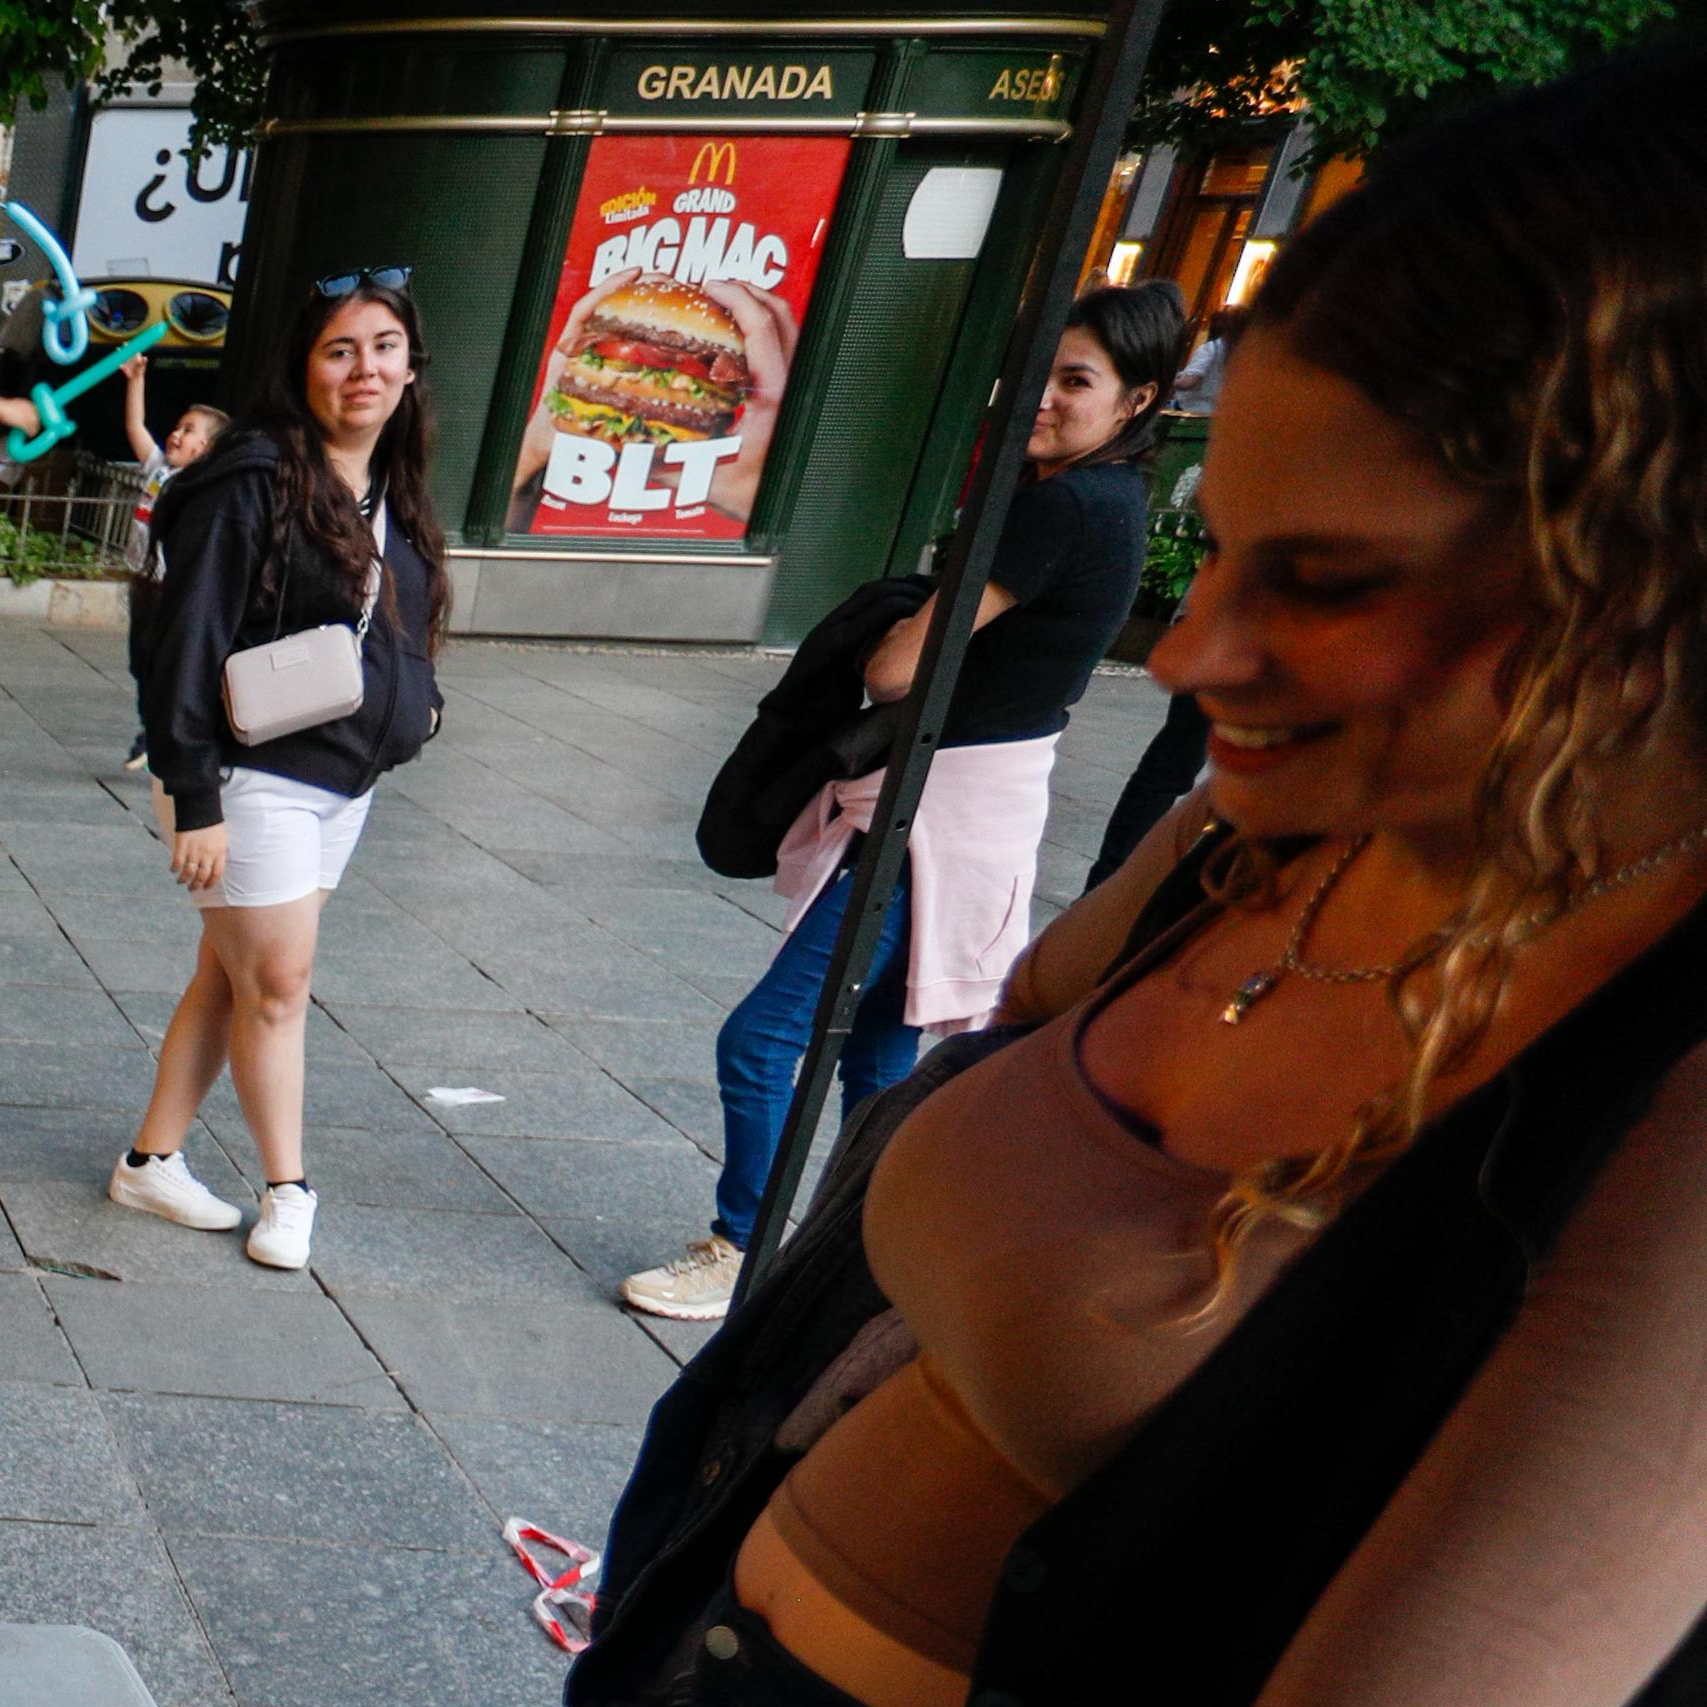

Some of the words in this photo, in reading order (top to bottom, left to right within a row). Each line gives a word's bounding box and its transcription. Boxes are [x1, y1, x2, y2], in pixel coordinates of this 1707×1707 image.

[637, 64, 833, 101] GRANADA
[672, 187, 736, 214] GRAND
[588, 217, 682, 289] BIG
[674, 216, 788, 290] MAC
[542, 431, 743, 511] BLT
